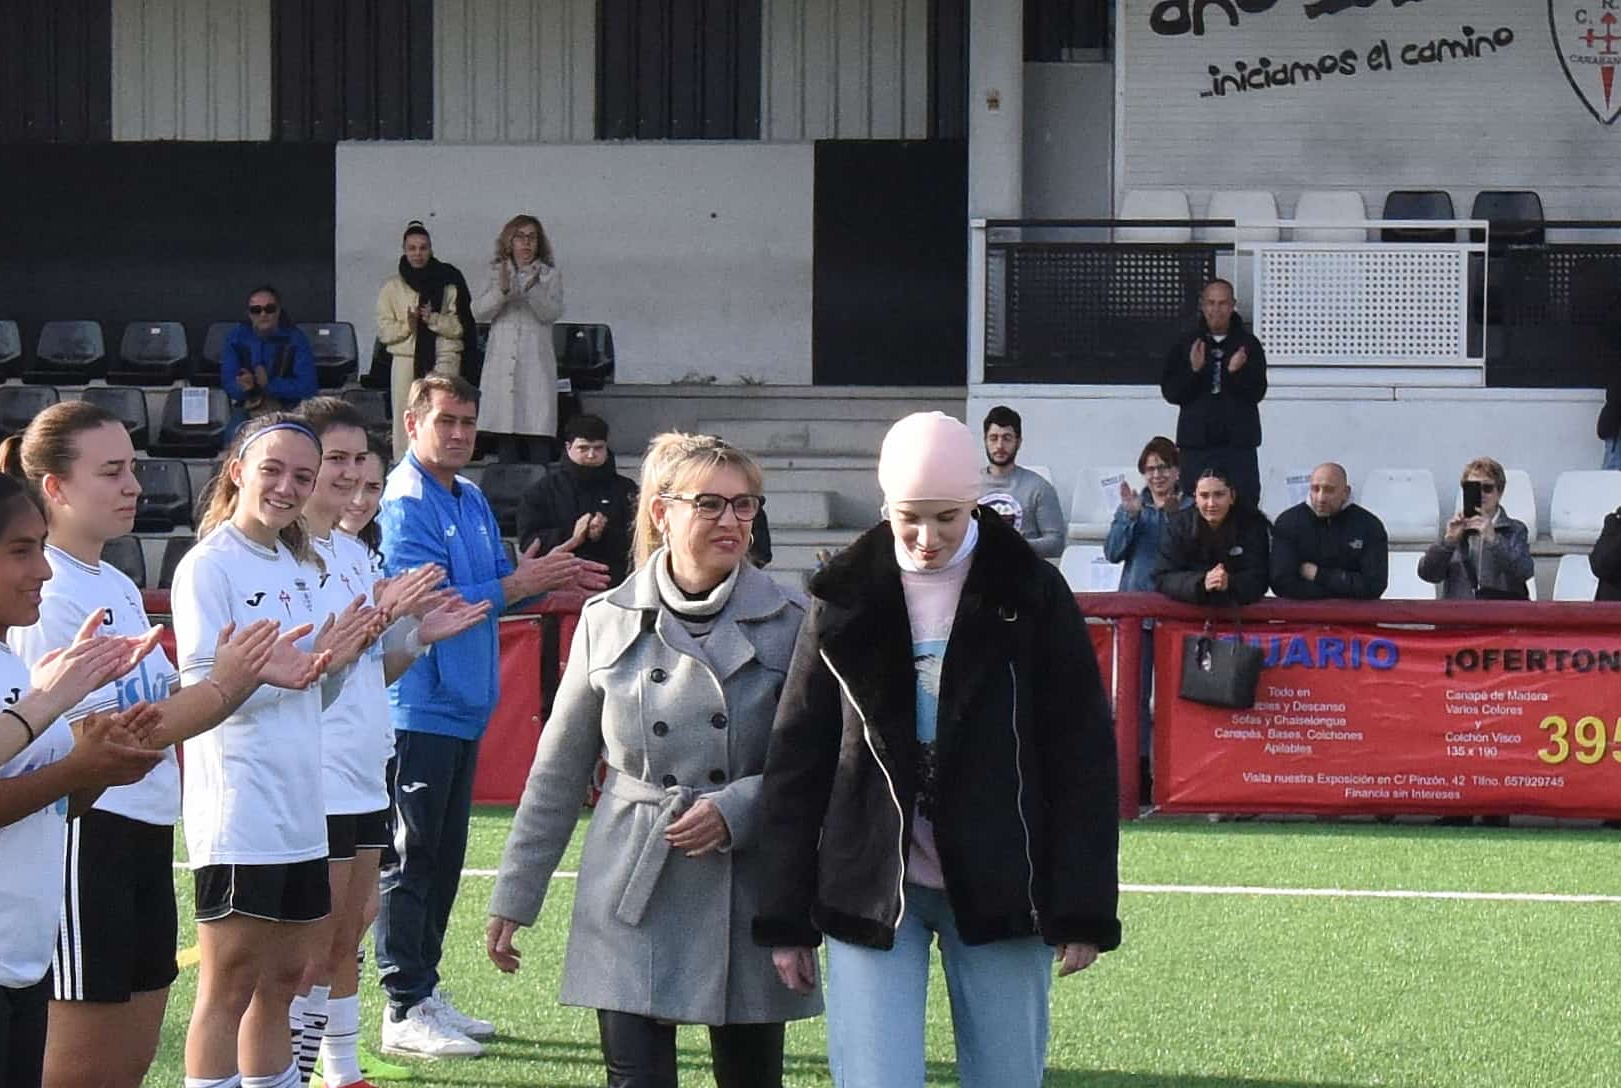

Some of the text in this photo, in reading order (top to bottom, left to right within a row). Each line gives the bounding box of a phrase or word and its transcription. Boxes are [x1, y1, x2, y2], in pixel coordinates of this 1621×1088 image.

[1367, 40, 1392, 71] el
[1401, 26, 1514, 65] camino
[1490, 690, 1504, 701] de
[1293, 701, 1346, 712] Descanso
[1445, 704, 1523, 715] Varios Colores
[1307, 729, 1364, 741] Colchones
[1491, 732, 1522, 743] Visco
[1242, 772, 1272, 784] Visita
[1274, 774, 1315, 785] nuestra
[1377, 775, 1391, 785] en
[1451, 775, 1466, 786] 42
[1392, 788, 1409, 799] sin
